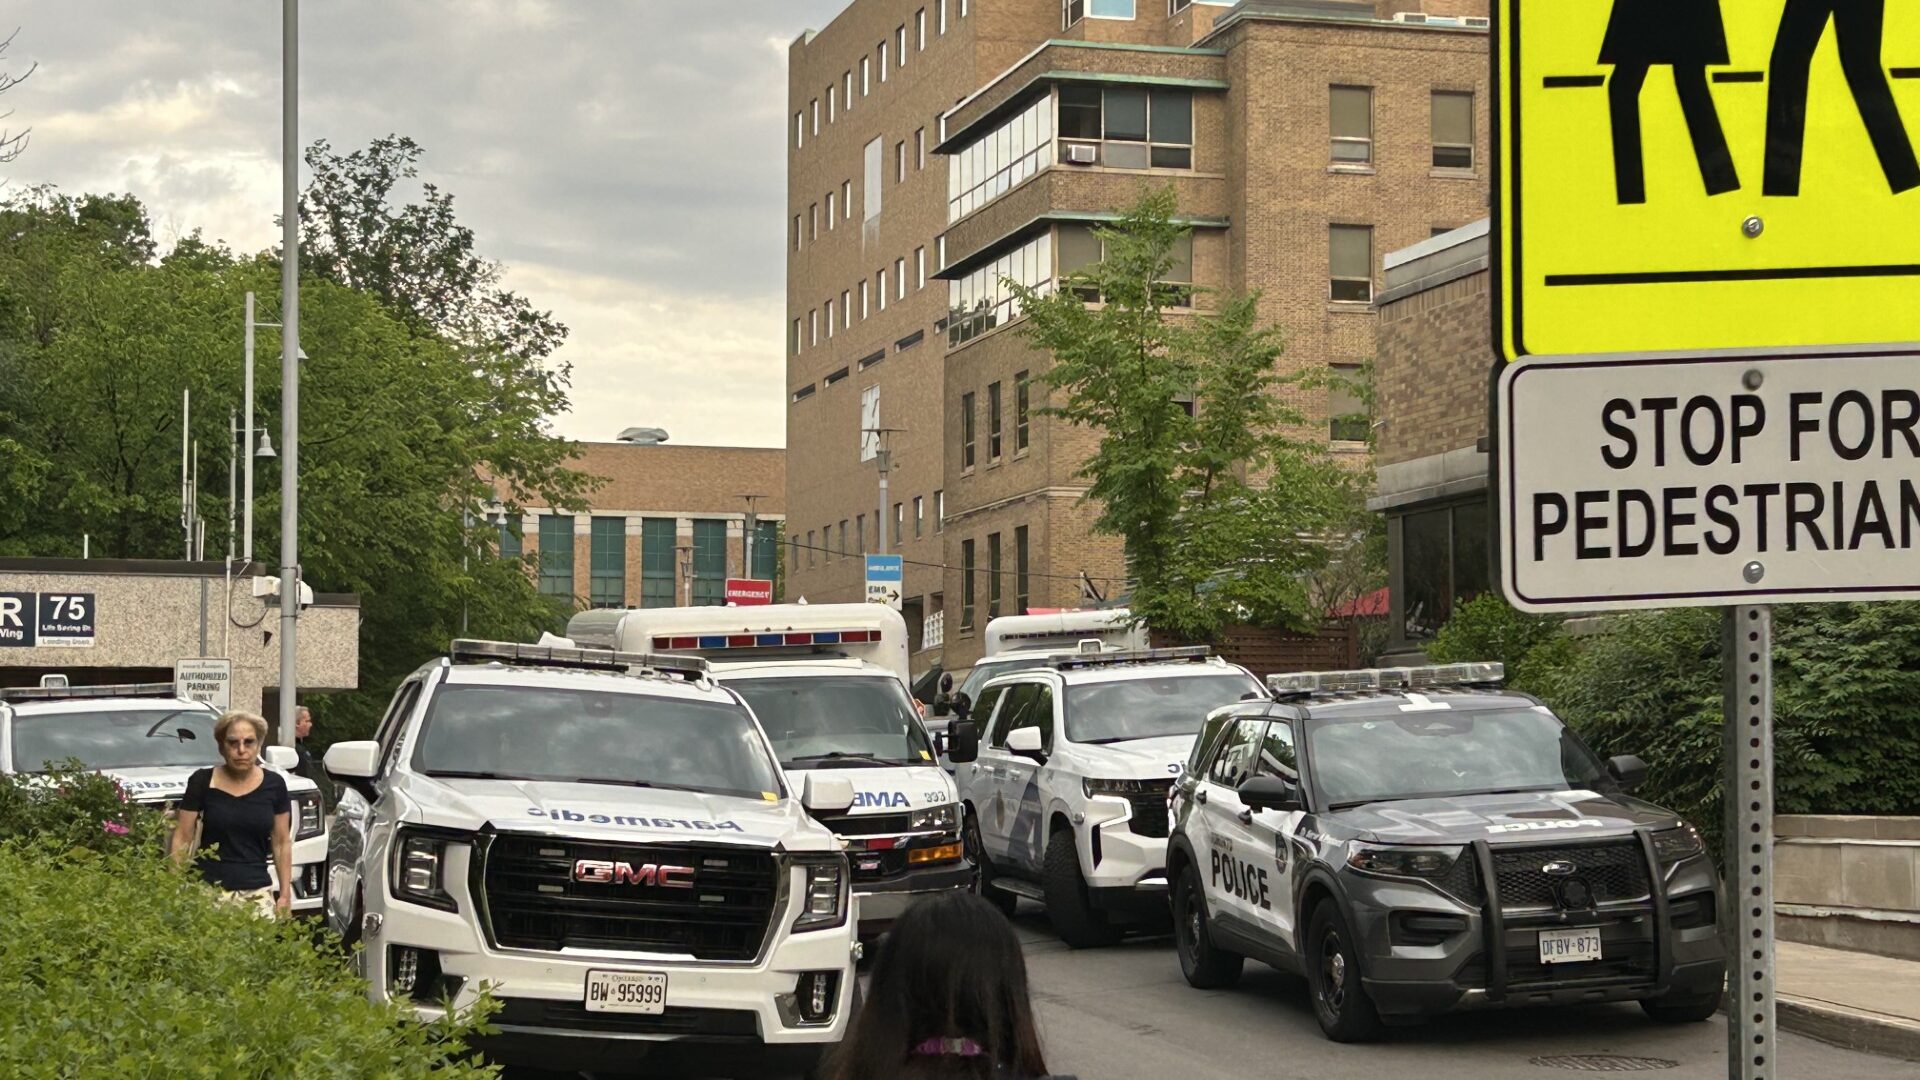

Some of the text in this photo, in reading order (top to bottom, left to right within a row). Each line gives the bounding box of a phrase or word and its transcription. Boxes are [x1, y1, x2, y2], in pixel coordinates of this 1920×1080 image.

[1600, 389, 1920, 470] STOP FOR
[50, 596, 85, 620] 75
[180, 672, 228, 681] AUTHORIZED
[186, 682, 220, 692] PARKING
[575, 859, 695, 889] GMC
[1210, 848, 1271, 911] POLICE
[617, 983, 662, 1003] 95999
